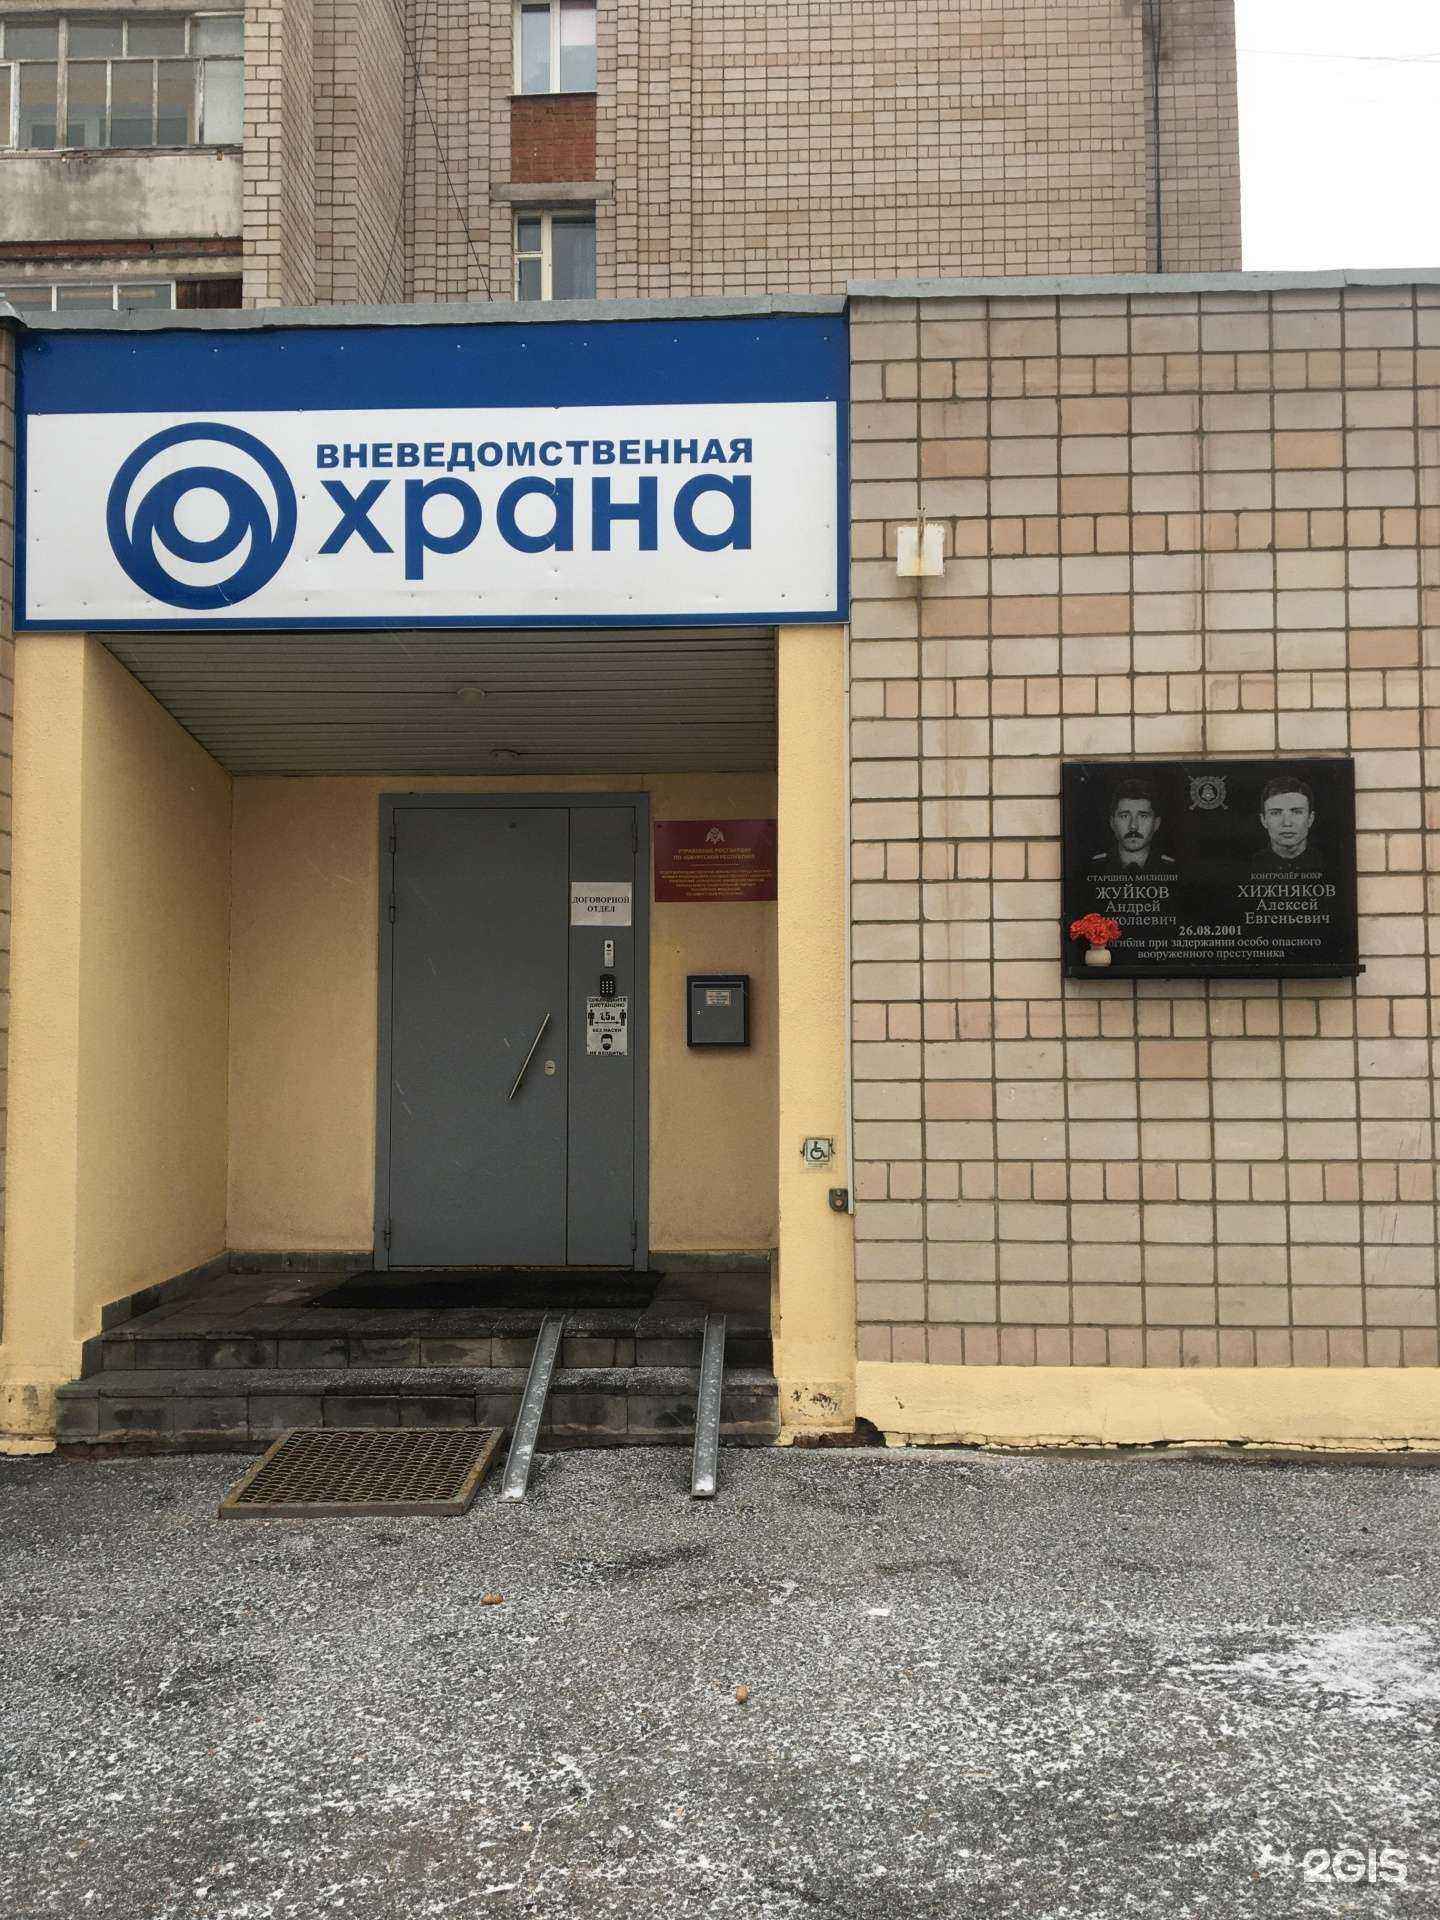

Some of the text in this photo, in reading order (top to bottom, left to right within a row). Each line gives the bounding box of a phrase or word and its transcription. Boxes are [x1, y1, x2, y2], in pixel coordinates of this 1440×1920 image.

[315, 437, 753, 472] ВНЕВЕДОМСТВЕННАЯ
[1095, 883, 1170, 900] ЖУЙКОВ
[1237, 884, 1337, 898] ХИЖНЯКОВ
[572, 896, 630, 904] ДОГОВОРНОЙ
[1256, 898, 1320, 911] Алексей
[587, 905, 616, 913] ОТДЕЛ
[1105, 900, 1161, 915] Андрей
[1244, 912, 1331, 924] Евгеньевич
[1179, 925, 1243, 936] 26.08.2001
[1149, 940, 1169, 949] при
[1172, 938, 1235, 949] задержании
[1237, 937, 1270, 947] особо
[1272, 938, 1323, 947] опасного
[1137, 950, 1286, 960] вооруженного преступника
